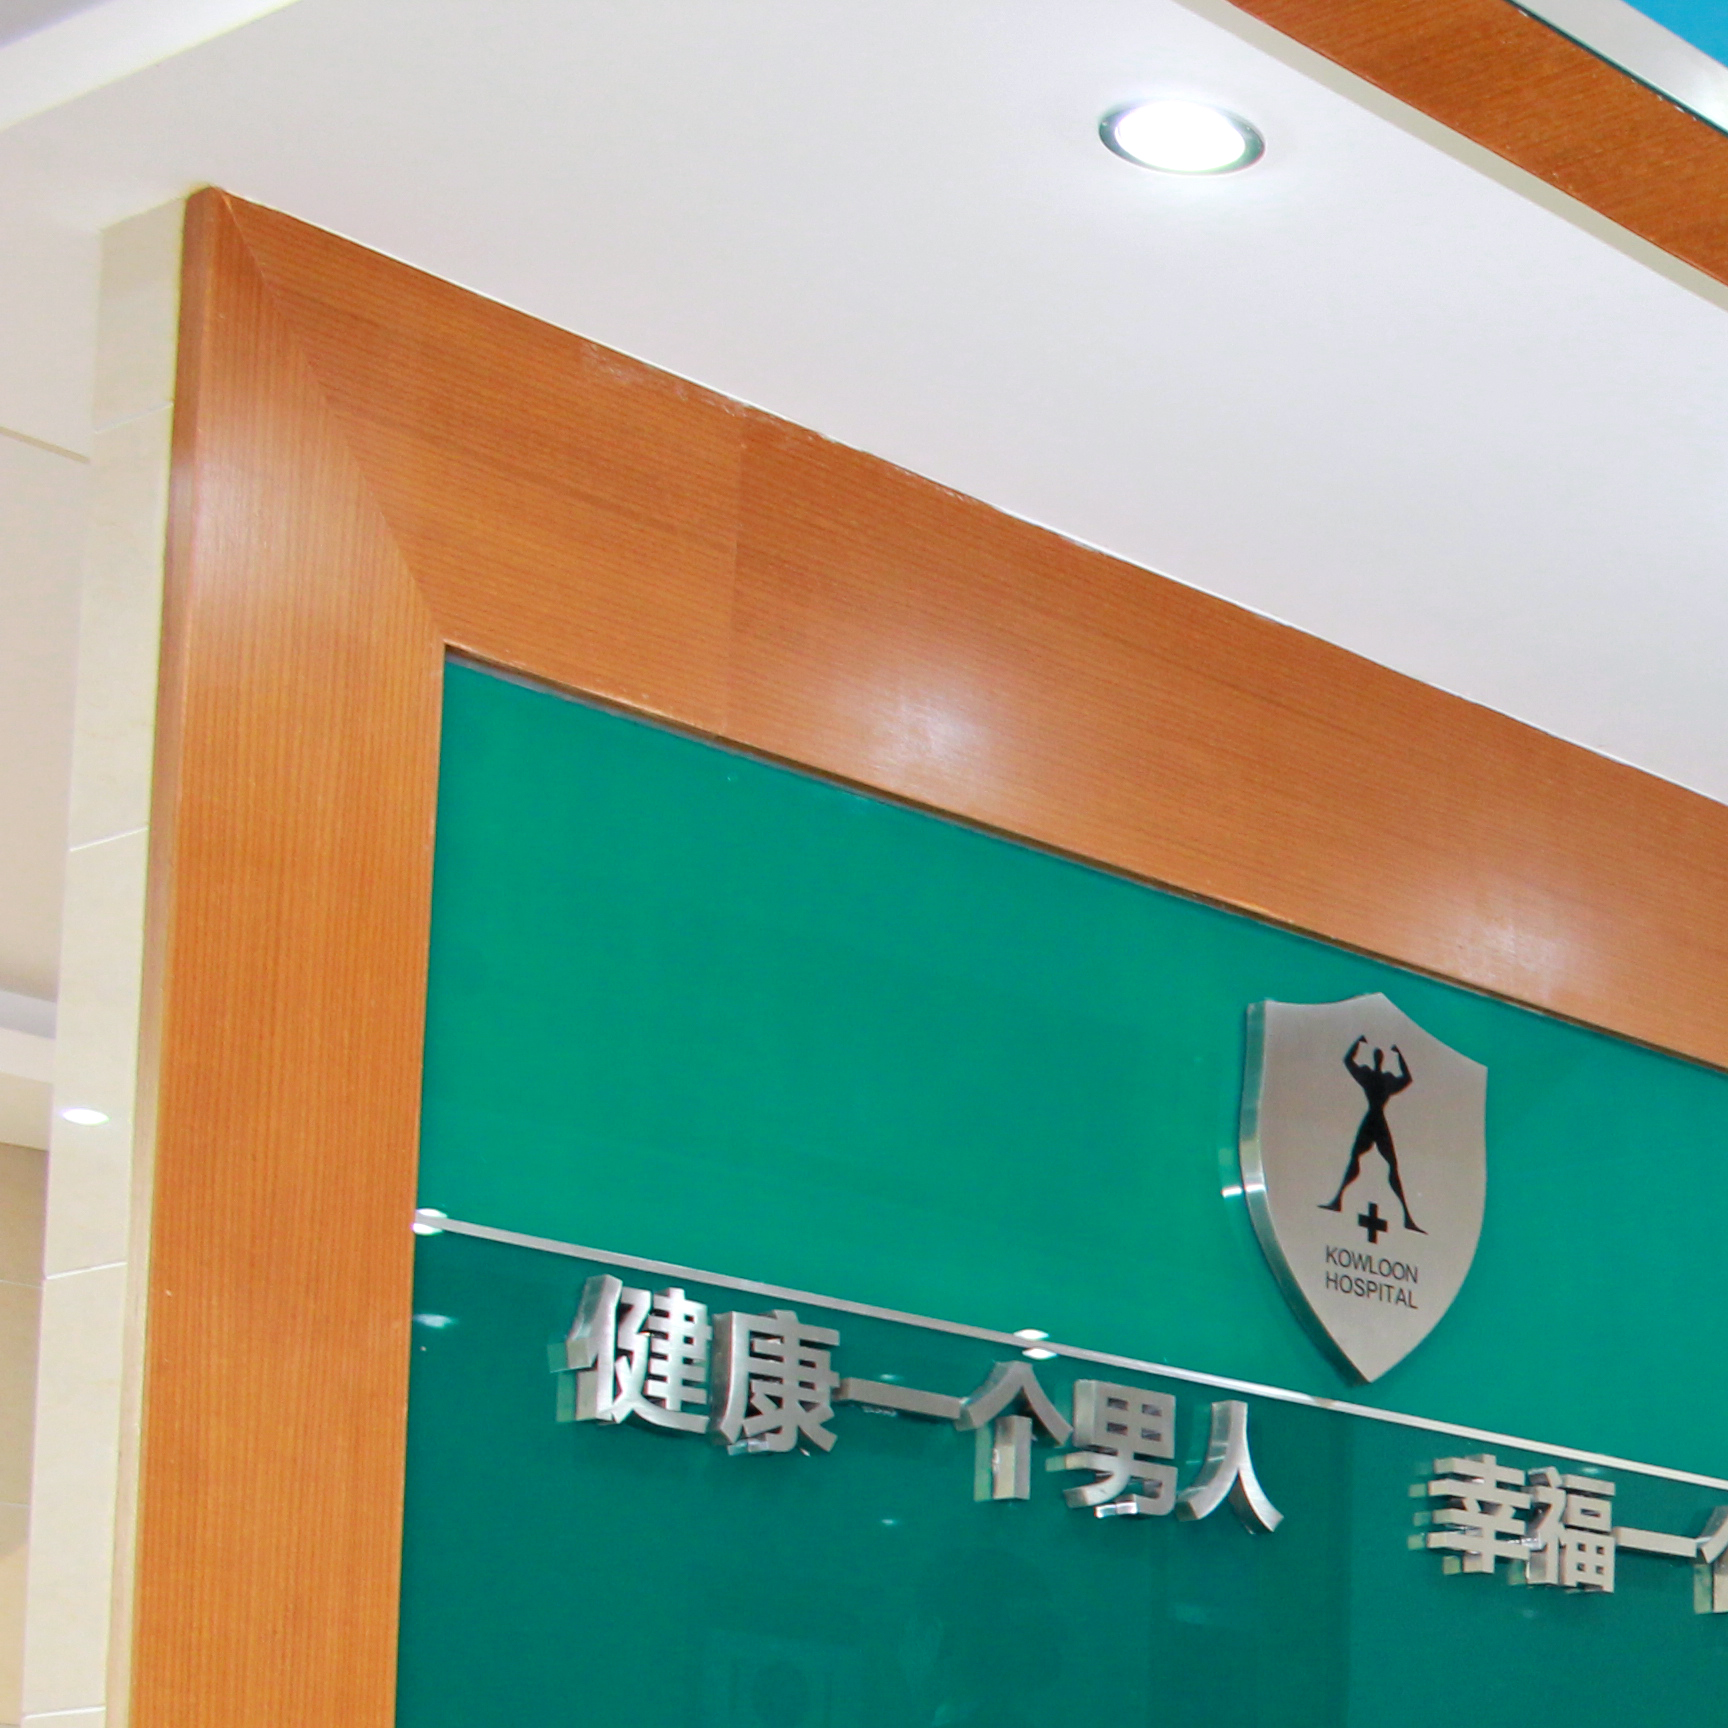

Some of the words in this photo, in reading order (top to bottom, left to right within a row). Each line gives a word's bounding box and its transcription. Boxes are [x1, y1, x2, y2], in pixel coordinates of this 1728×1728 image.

[1325, 1245, 1419, 1284] KOWLOON
[1325, 1271, 1419, 1310] HOSPITAL
[565, 1275, 1283, 1533] 健康一个男人
